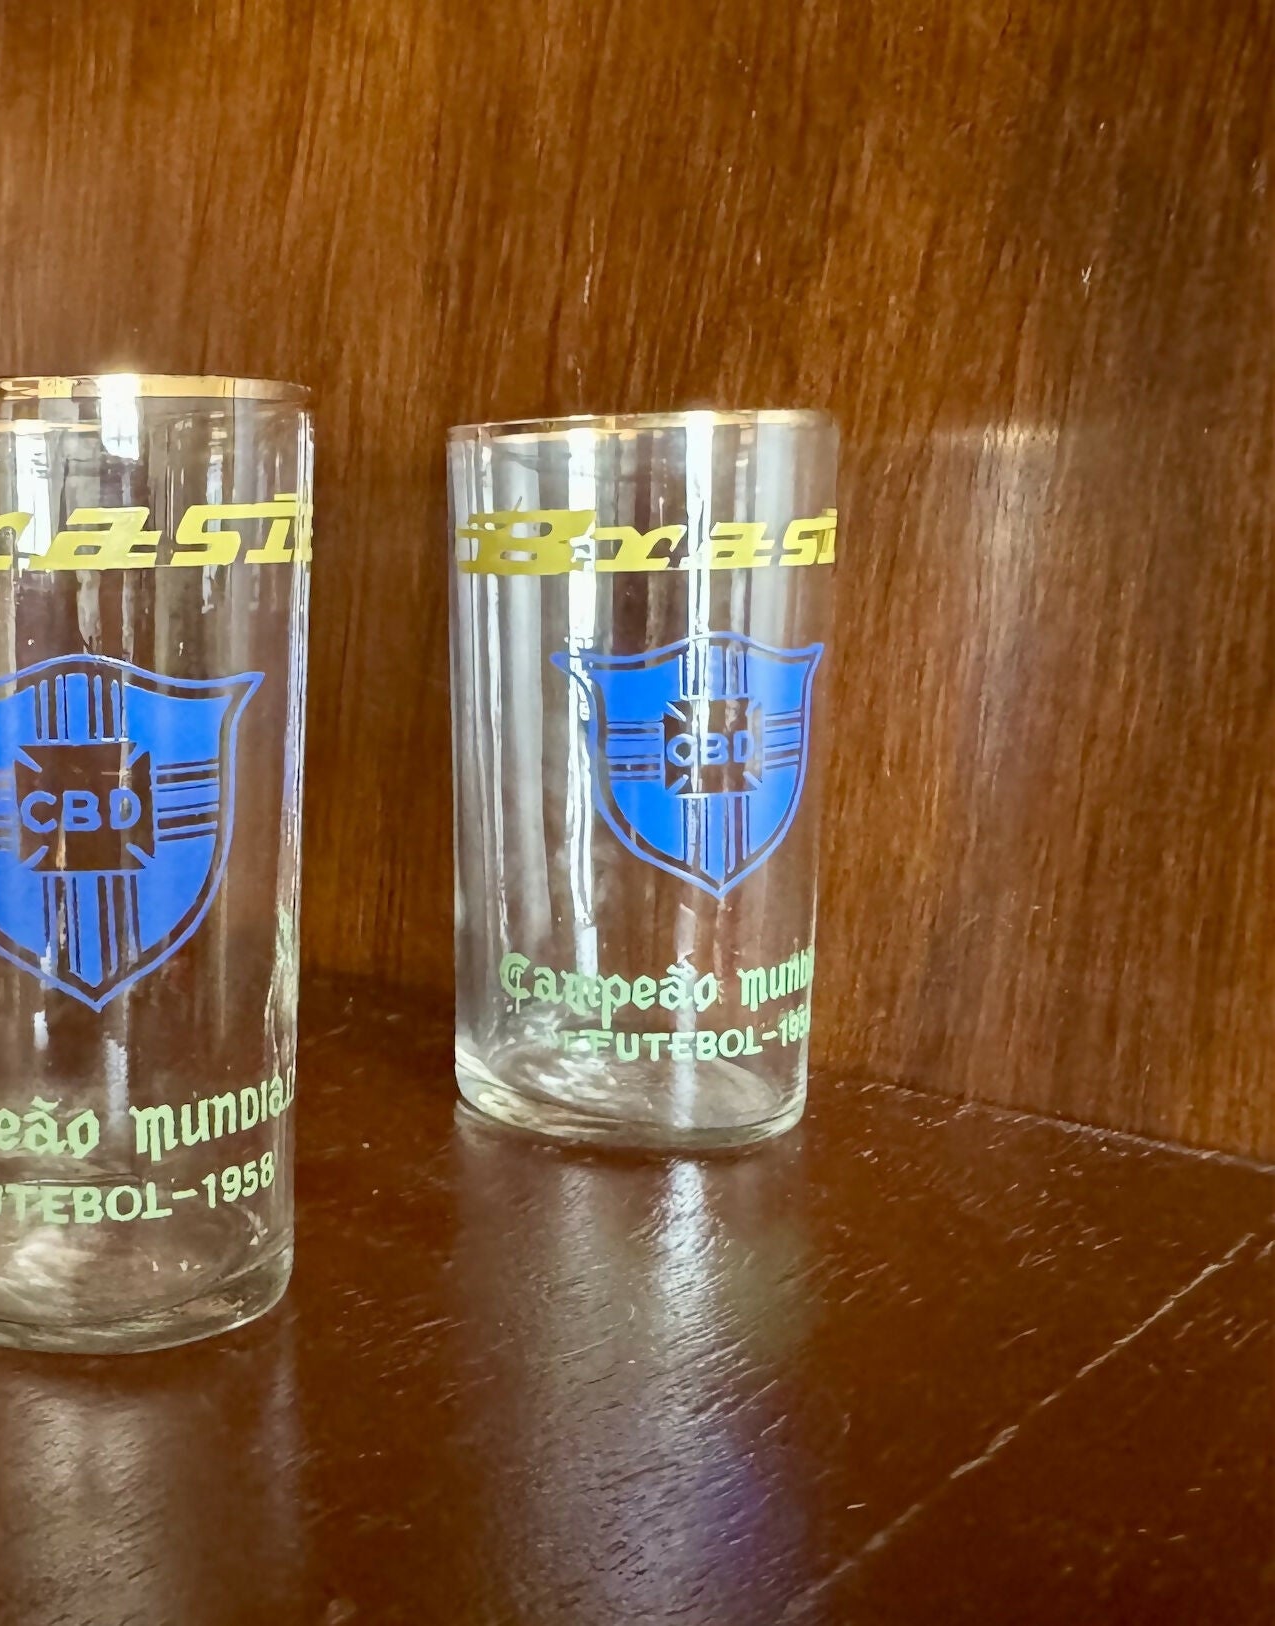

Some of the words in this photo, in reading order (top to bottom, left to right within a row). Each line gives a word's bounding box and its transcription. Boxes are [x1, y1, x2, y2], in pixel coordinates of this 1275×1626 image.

[456, 508, 837, 576] Brasi
[666, 730, 755, 767] CBD
[20, 787, 142, 833] CBD
[499, 953, 718, 1029] Campeão
